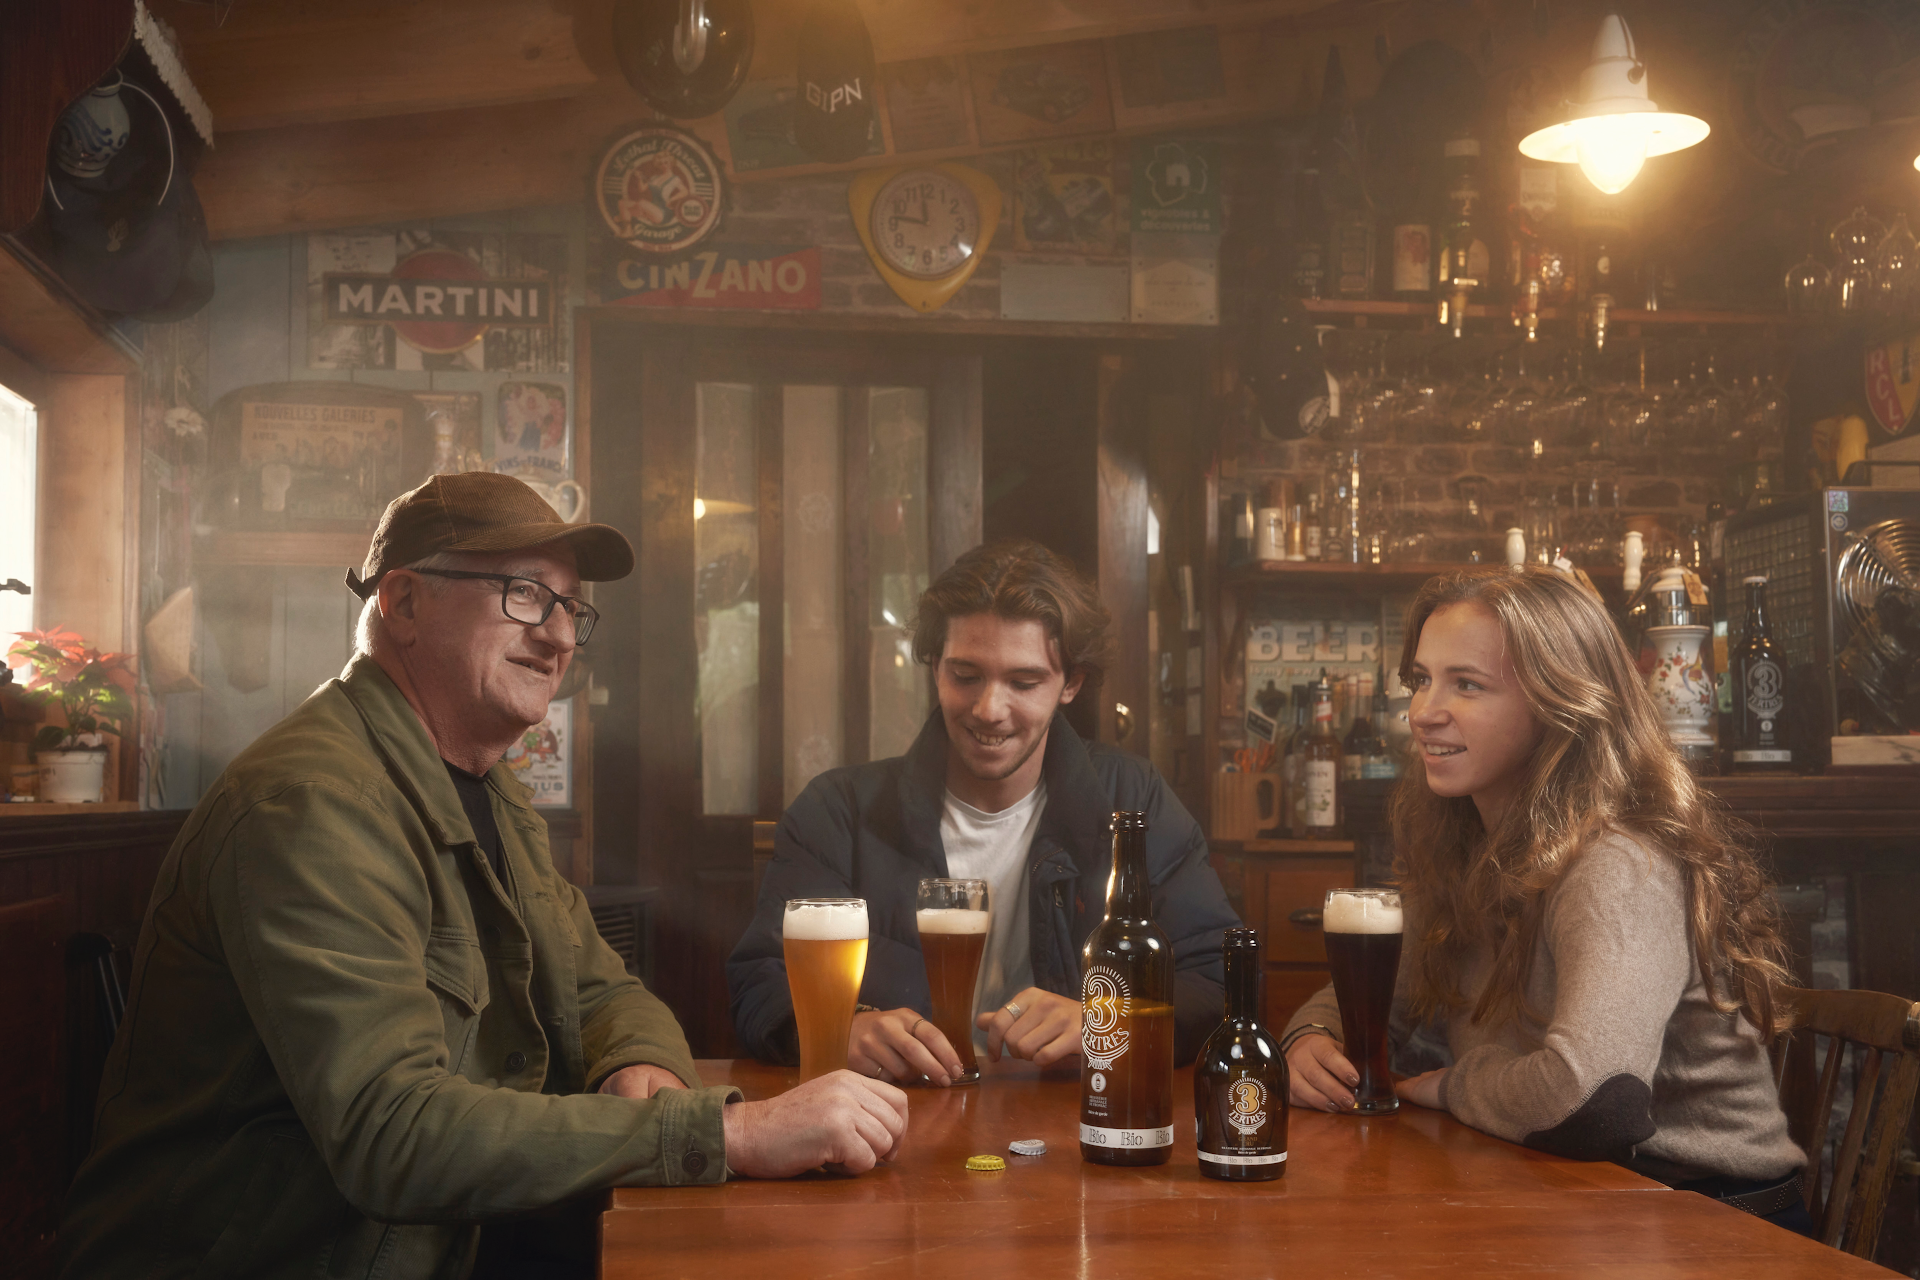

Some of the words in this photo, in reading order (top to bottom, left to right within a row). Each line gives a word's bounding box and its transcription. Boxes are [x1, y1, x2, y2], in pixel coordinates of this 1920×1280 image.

[806, 77, 863, 114] GIPN
[905, 186, 917, 202] 11
[920, 183, 934, 199] 12
[892, 199, 907, 215] 10
[949, 199, 960, 214] 2
[888, 216, 899, 231] 9
[955, 217, 965, 233] 3
[894, 232, 904, 249] 8
[949, 234, 958, 248] 4
[922, 249, 932, 266] 6
[617, 251, 807, 298] CINZANO
[338, 283, 539, 317] MARTINI
[253, 405, 317, 422] NOUVELLES
[321, 408, 376, 424] GALERIES
[1248, 624, 1379, 662] BEER
[1754, 664, 1777, 699] 3
[1087, 974, 1117, 1033] 3
[1082, 1022, 1130, 1051] TERTRES
[1236, 1082, 1260, 1115] 3
[1229, 1110, 1266, 1125] TERTRES
[1089, 1128, 1107, 1144] Bio
[1121, 1132, 1143, 1145] Bio
[1156, 1130, 1169, 1145] Bio
